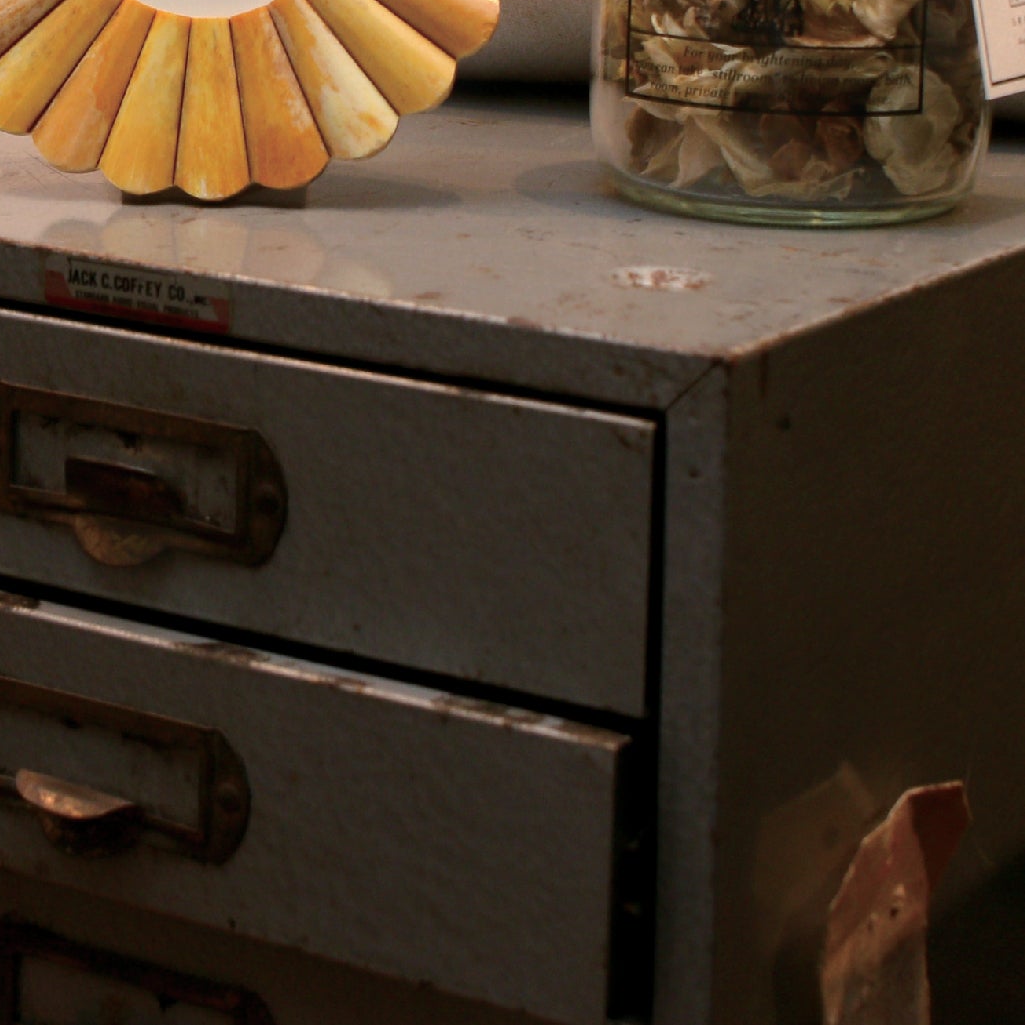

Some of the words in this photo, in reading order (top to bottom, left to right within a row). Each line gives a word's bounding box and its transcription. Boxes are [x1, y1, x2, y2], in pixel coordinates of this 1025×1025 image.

[683, 45, 704, 57] For
[67, 268, 98, 286] JACK
[114, 275, 163, 298] COFFEY
